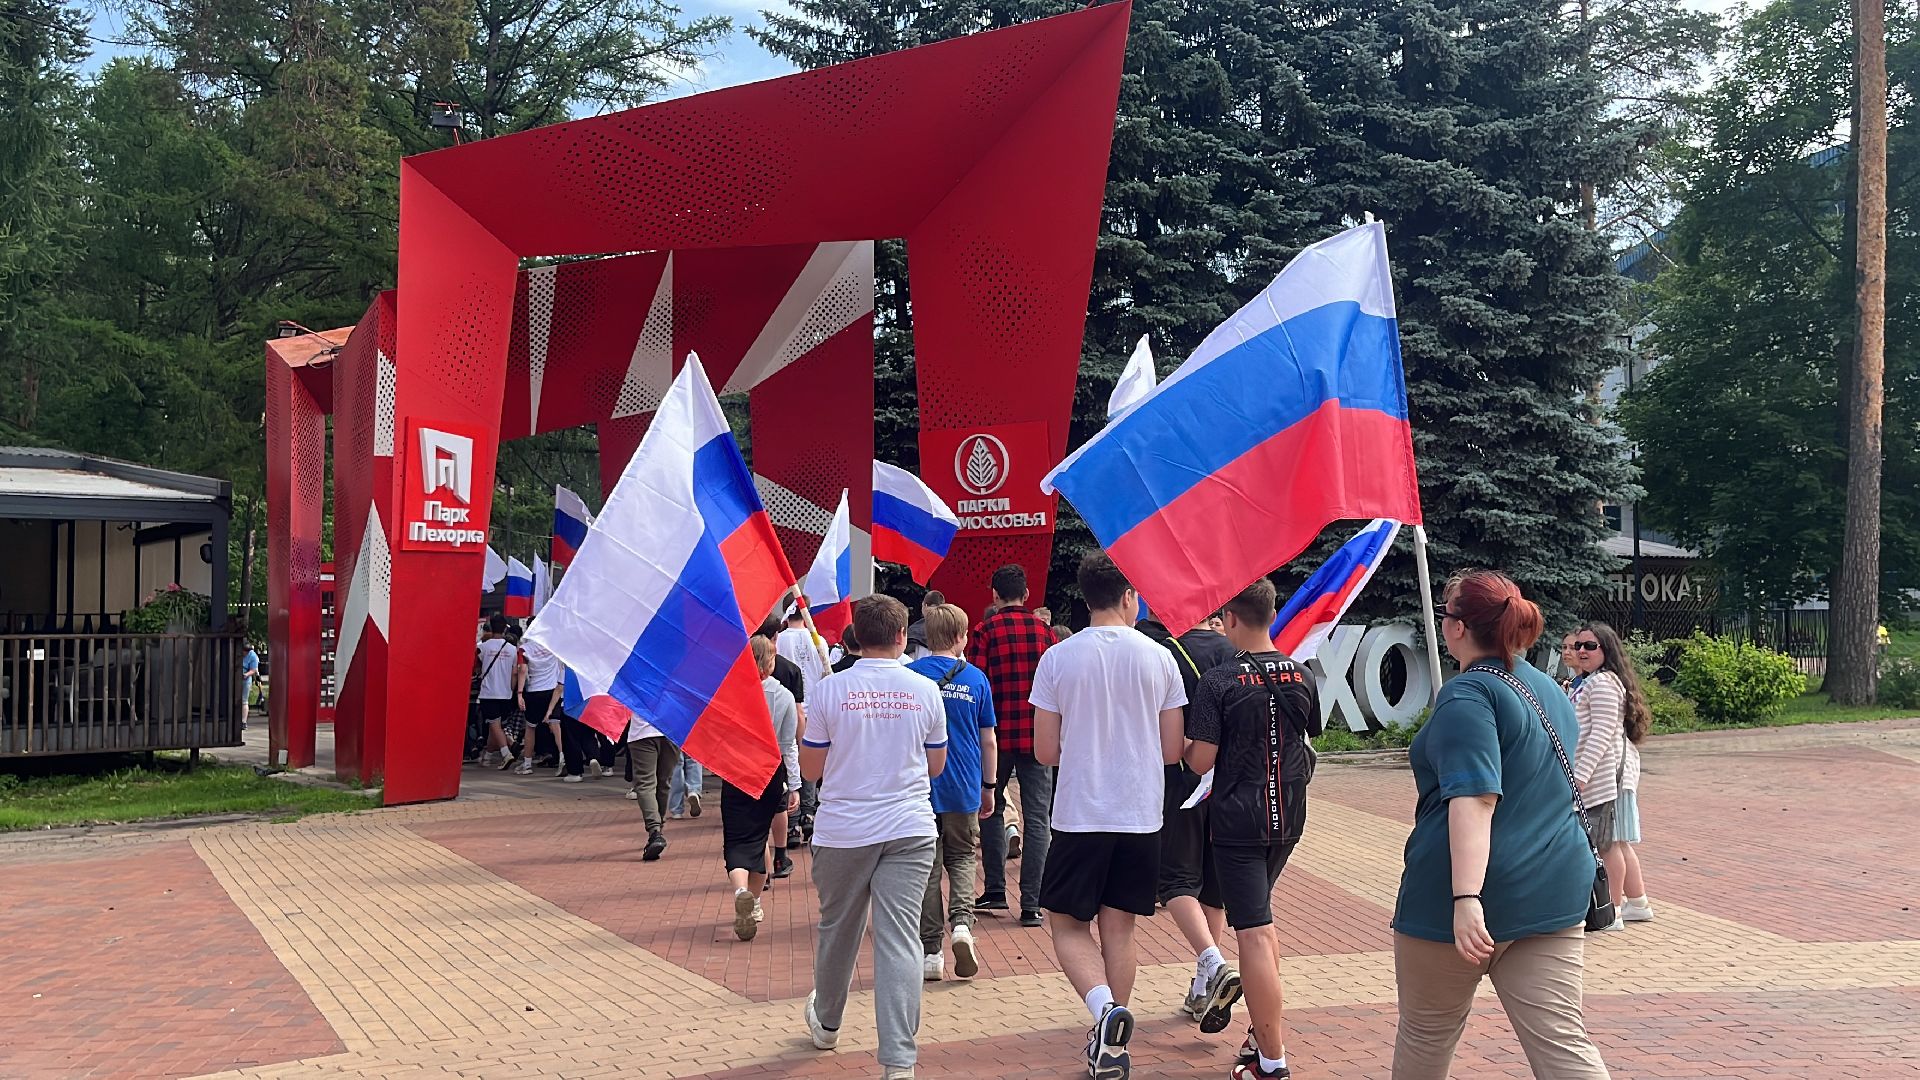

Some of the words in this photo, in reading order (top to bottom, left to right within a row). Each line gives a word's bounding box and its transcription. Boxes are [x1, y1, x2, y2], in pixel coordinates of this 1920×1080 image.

[423, 500, 471, 526] Парк
[957, 498, 1010, 513] ПАРКИ
[957, 511, 1047, 530] МОСКОВЬЯ
[408, 521, 485, 547] Пехорка
[1240, 661, 1295, 673] TAM
[848, 691, 915, 701] ВОЛОНТЕРЫ
[841, 701, 922, 712] ПОДМОСКОВЬЯ
